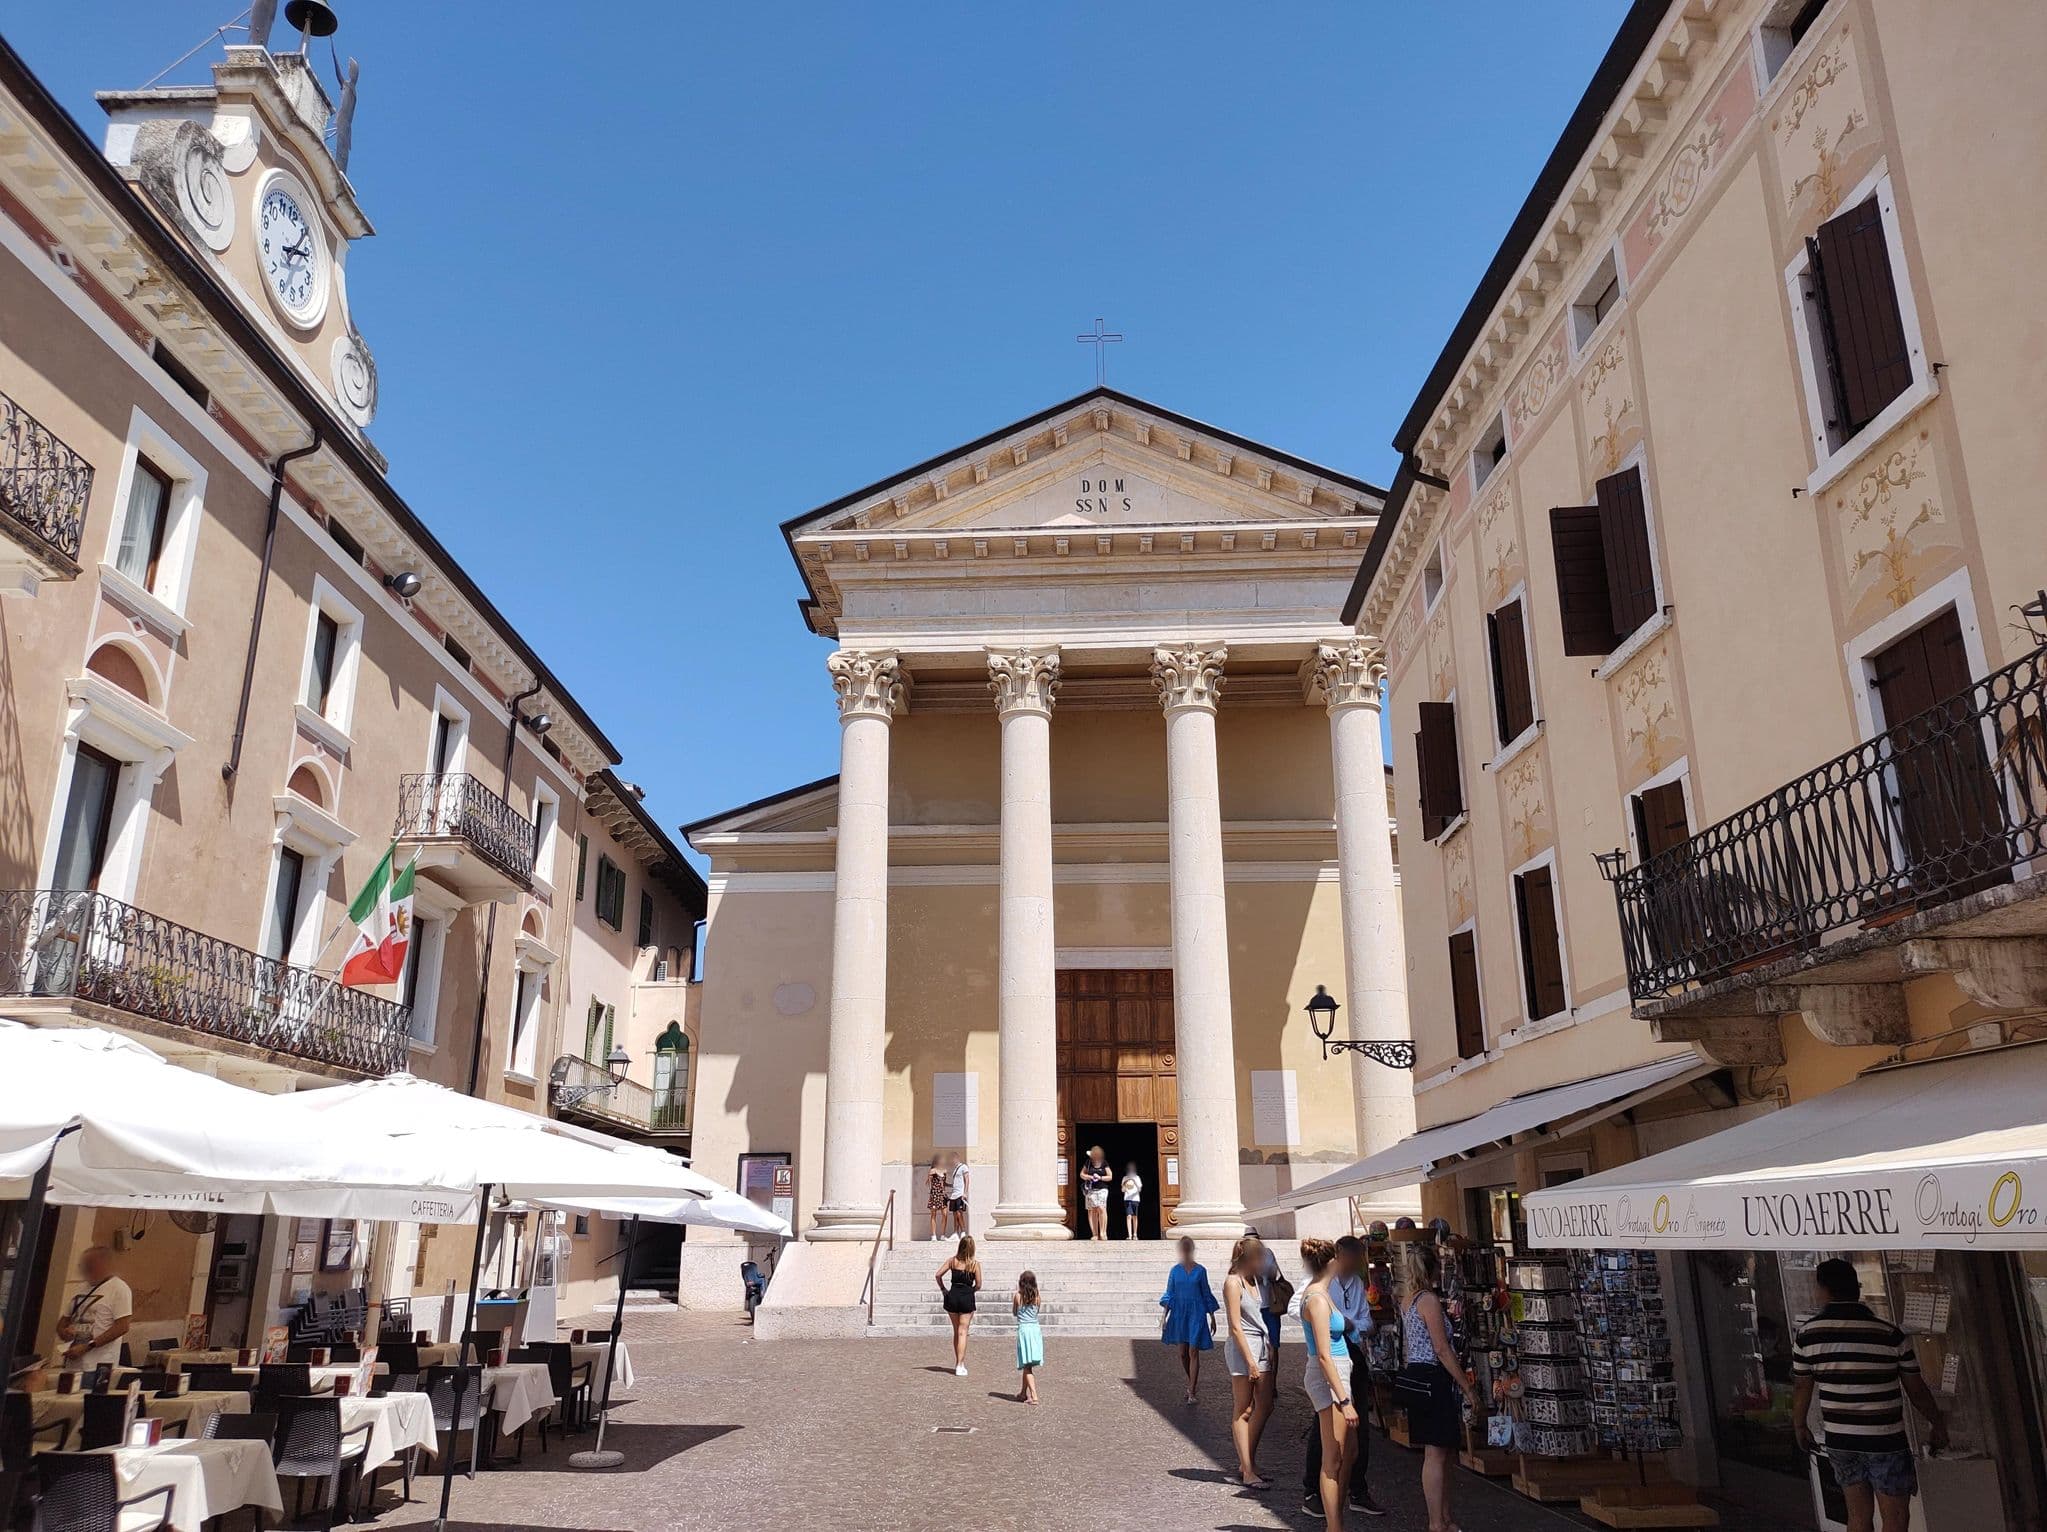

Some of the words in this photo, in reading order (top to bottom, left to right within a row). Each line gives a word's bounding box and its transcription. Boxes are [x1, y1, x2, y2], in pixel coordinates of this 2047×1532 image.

[269, 200, 278, 221] 10
[279, 198, 286, 217] 11
[289, 205, 298, 227] 12
[264, 238, 270, 254] 8
[269, 260, 278, 275] 7
[304, 270, 311, 286] 3
[289, 286, 296, 302] 5
[298, 285, 305, 299] 4
[411, 1200, 454, 1217] CAFFETTERIA
[1742, 1188, 1900, 1238] UNOAERRE
[1915, 1173, 1983, 1244] Orologi
[1988, 1171, 2038, 1228] Oro
[1531, 1204, 1612, 1239] UNOAERRE
[1616, 1194, 1650, 1244] Orologi
[1653, 1194, 1679, 1233] Oro
[1683, 1193, 1726, 1241] Argento
